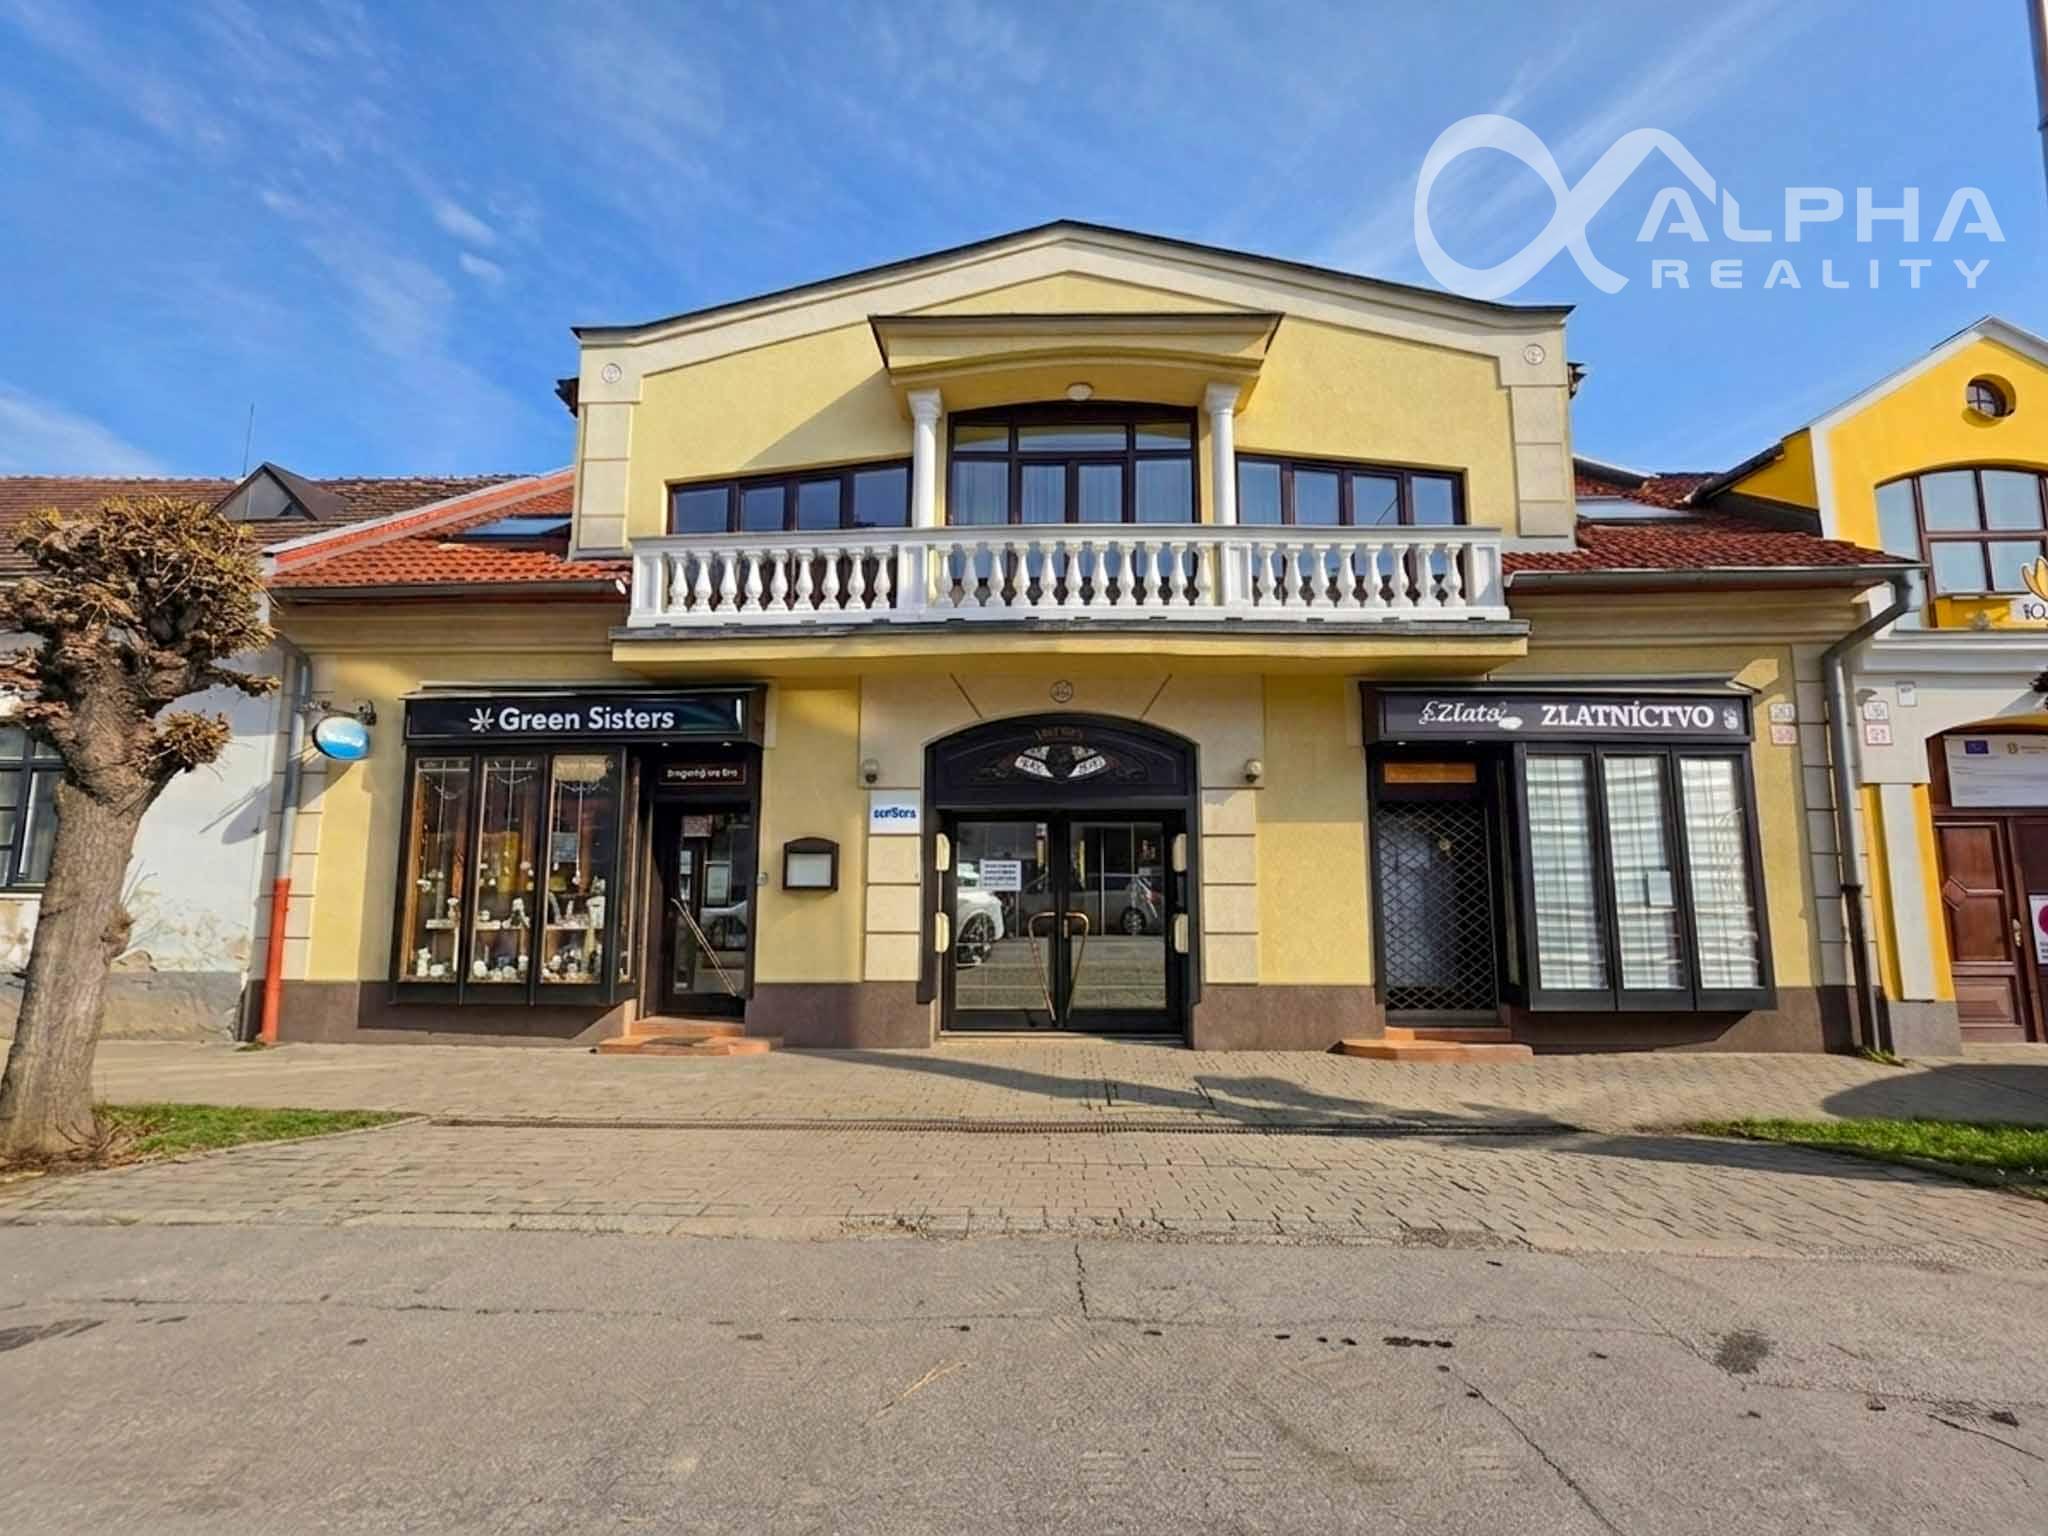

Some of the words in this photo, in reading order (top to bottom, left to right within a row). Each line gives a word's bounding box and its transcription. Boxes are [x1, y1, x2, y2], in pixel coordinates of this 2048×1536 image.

[499, 707, 580, 731] Green
[588, 706, 675, 730] Sisters
[1541, 700, 1714, 729] ZLATNÍCTVO
